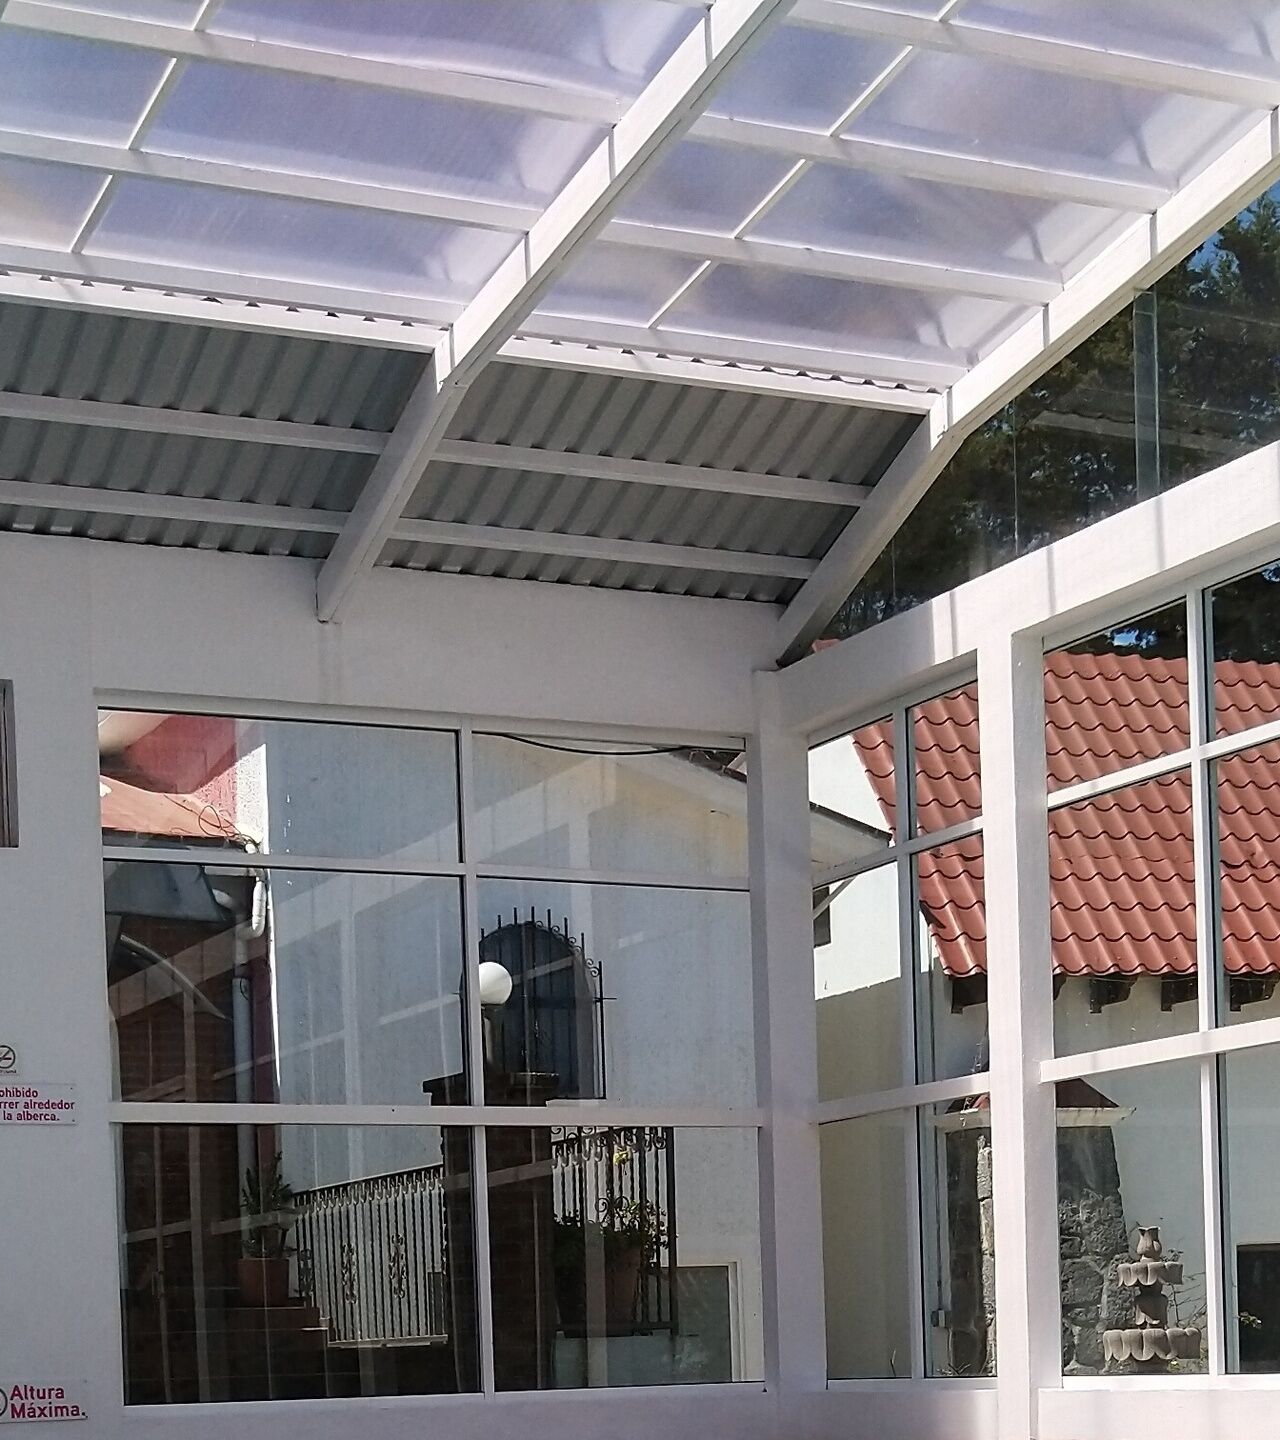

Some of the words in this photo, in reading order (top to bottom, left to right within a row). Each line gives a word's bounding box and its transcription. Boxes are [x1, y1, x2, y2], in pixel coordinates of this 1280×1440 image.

[24, 1100, 75, 1110] alrededor
[3, 1111, 13, 1121] la
[16, 1111, 60, 1121] alberca.
[10, 1385, 64, 1400] Altura
[10, 1402, 86, 1419] Máxima.
